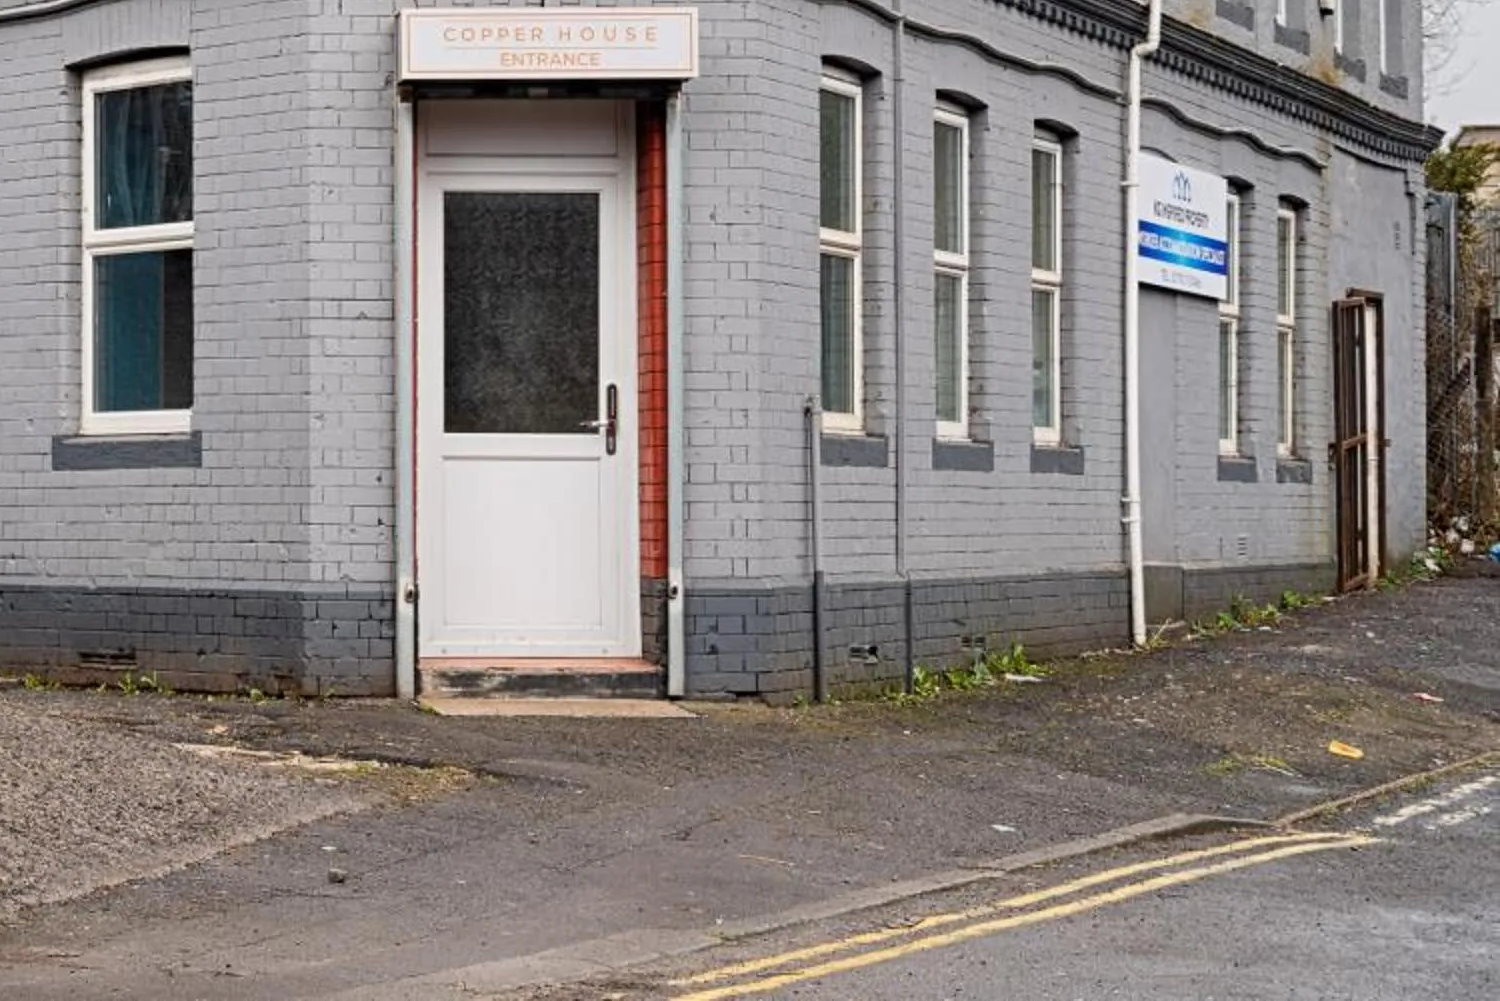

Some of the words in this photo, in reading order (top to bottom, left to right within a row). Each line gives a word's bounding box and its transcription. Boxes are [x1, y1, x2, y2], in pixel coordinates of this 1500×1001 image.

[443, 27, 543, 41] COPPER
[558, 27, 658, 41] HOUSE
[501, 53, 600, 67] ENTRANCE
